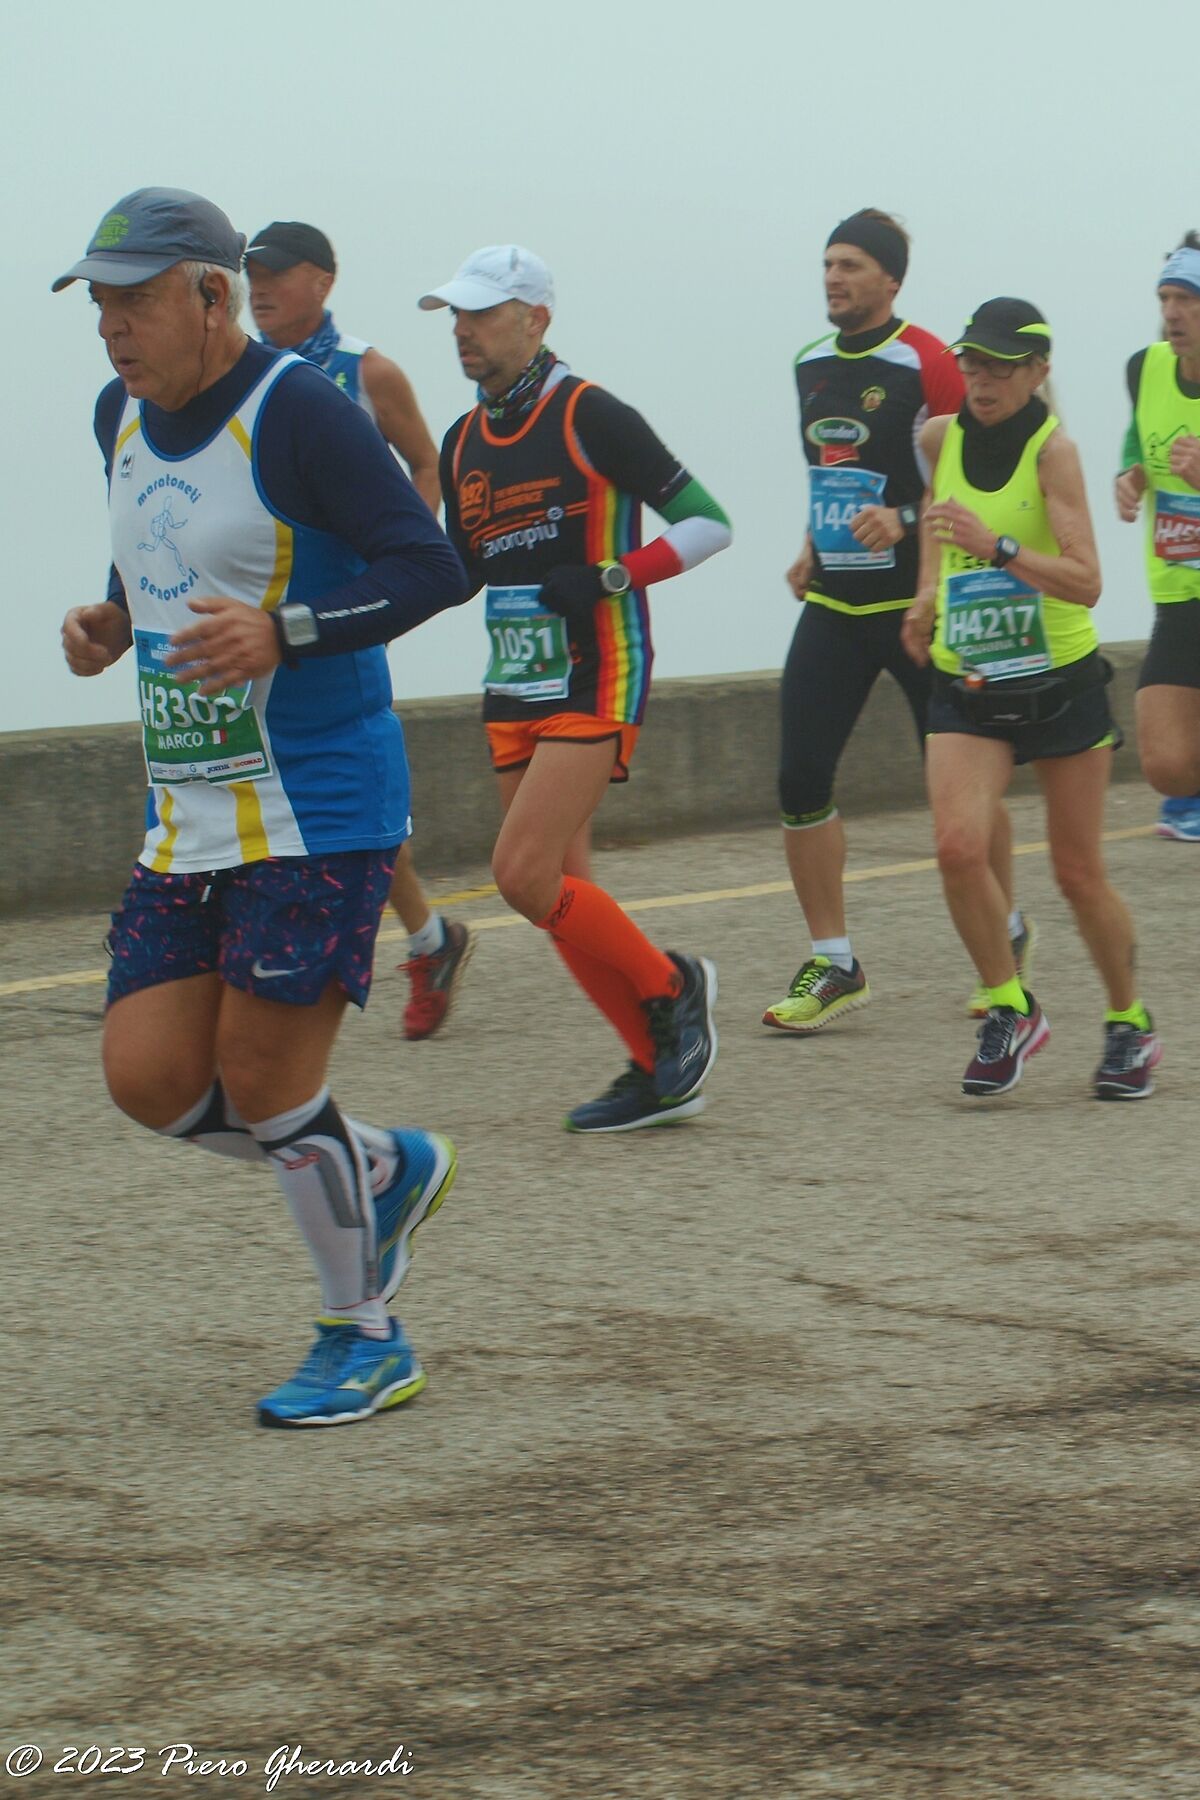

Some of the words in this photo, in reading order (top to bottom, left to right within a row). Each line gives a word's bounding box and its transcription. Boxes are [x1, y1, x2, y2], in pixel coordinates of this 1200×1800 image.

[137, 473, 202, 507] maratoneti
[812, 502, 876, 531] 144
[140, 567, 199, 601] genovesi
[949, 605, 1036, 645] H4217
[492, 626, 554, 661] 1051
[157, 731, 204, 750] MARCO
